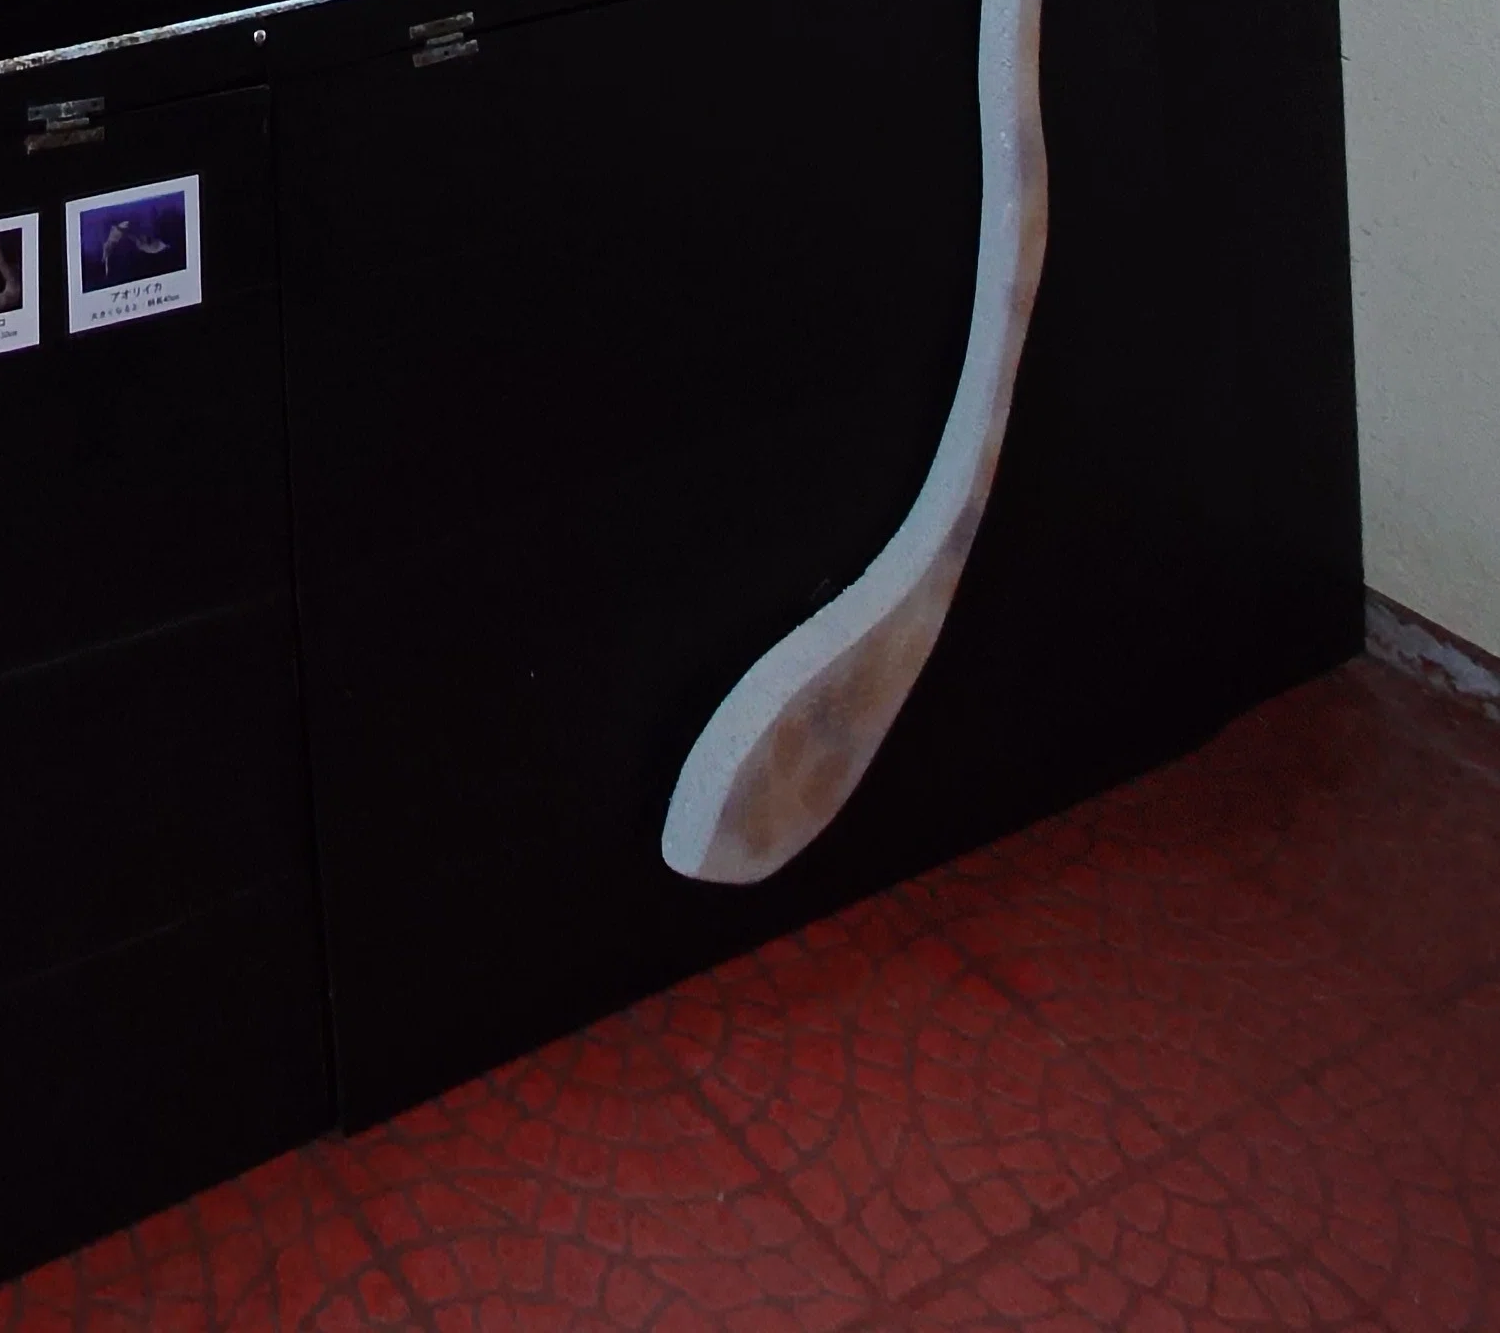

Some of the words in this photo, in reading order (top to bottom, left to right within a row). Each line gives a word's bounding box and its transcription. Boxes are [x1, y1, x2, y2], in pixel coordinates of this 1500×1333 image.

[110, 281, 163, 303] アオリイカ
